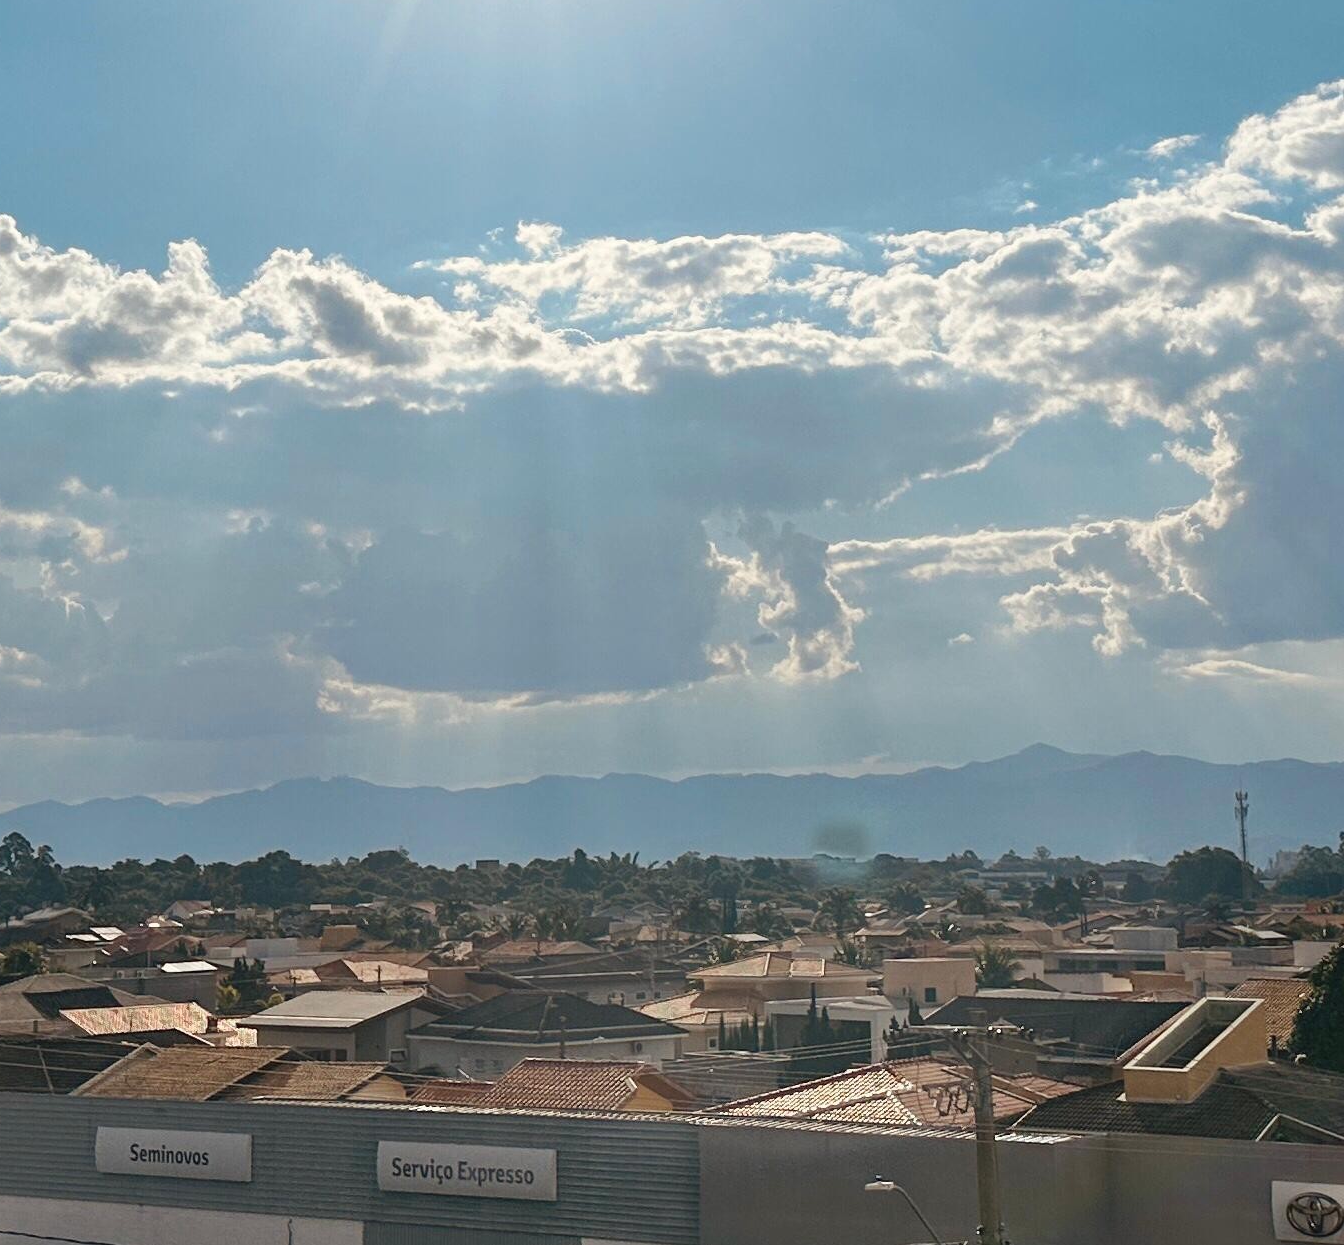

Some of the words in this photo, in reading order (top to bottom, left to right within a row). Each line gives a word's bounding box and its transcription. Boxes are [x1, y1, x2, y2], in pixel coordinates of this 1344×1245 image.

[129, 1143, 210, 1166] Seminovos
[391, 1157, 454, 1185] Serviço
[457, 1160, 535, 1187] Expresso
